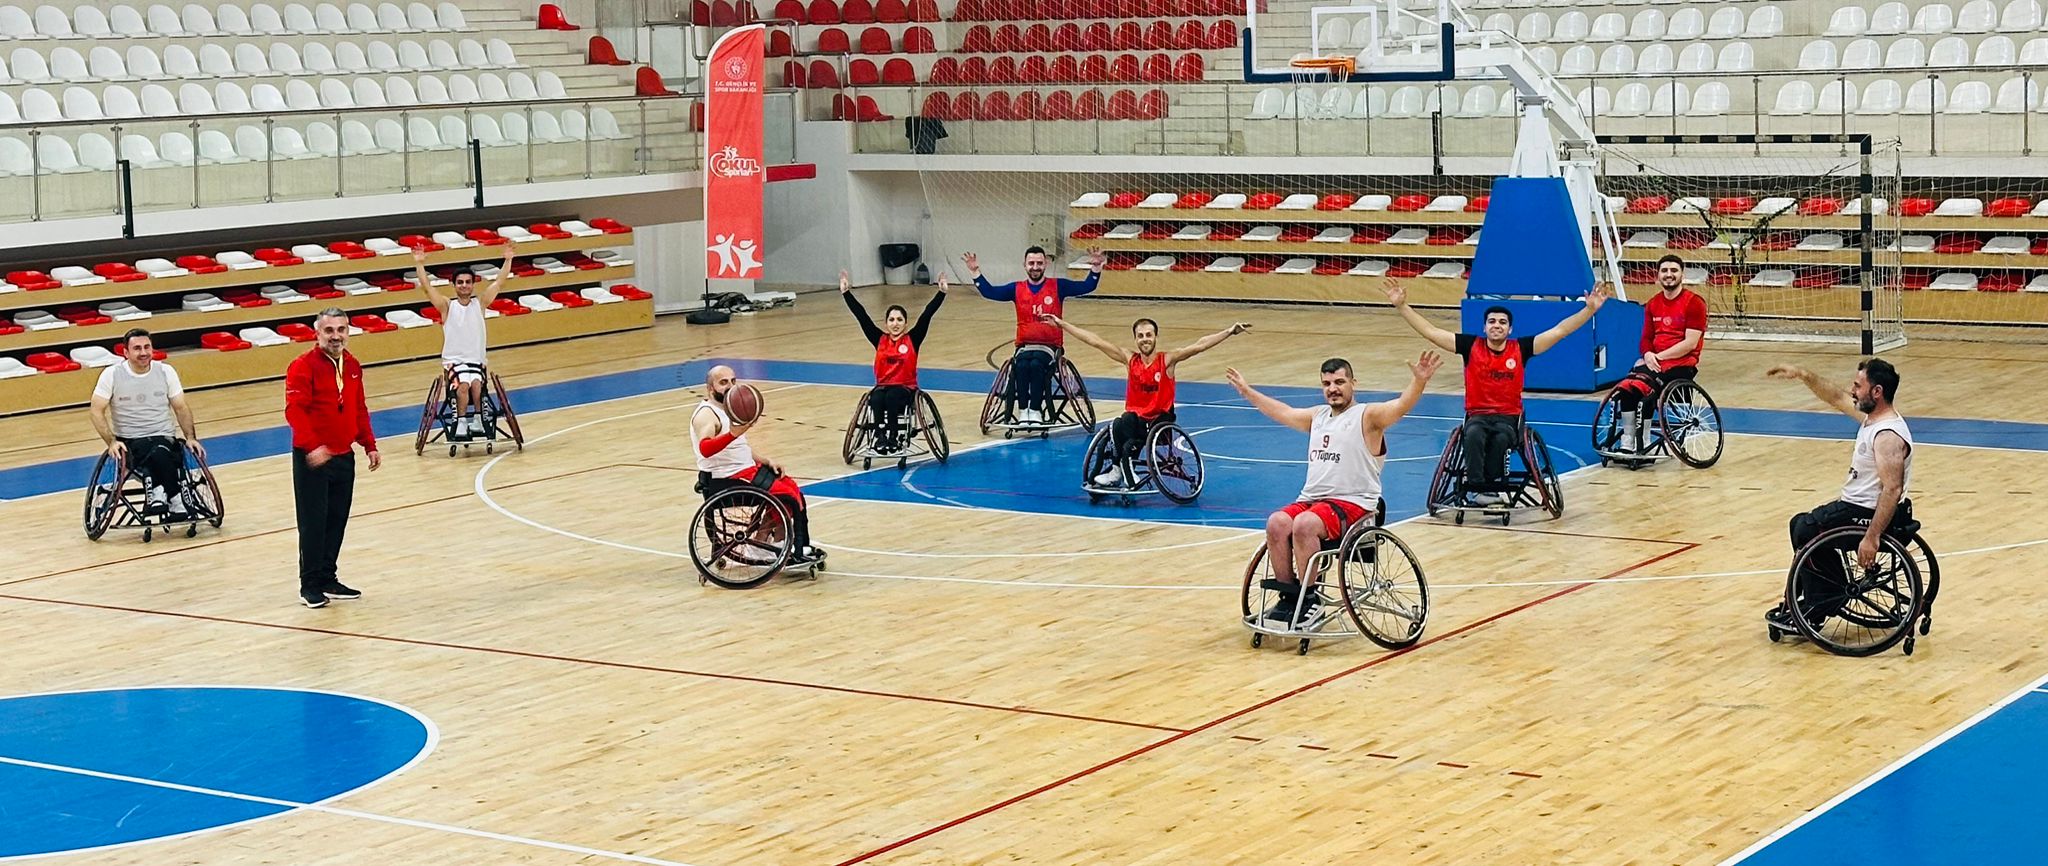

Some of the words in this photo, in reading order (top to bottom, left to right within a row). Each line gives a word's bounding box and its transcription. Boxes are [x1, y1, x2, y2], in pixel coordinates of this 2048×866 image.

[717, 158, 761, 173] OKUL
[1032, 304, 1043, 316] 14
[1636, 401, 1644, 430] EXTRA
[1322, 434, 1330, 449] 9
